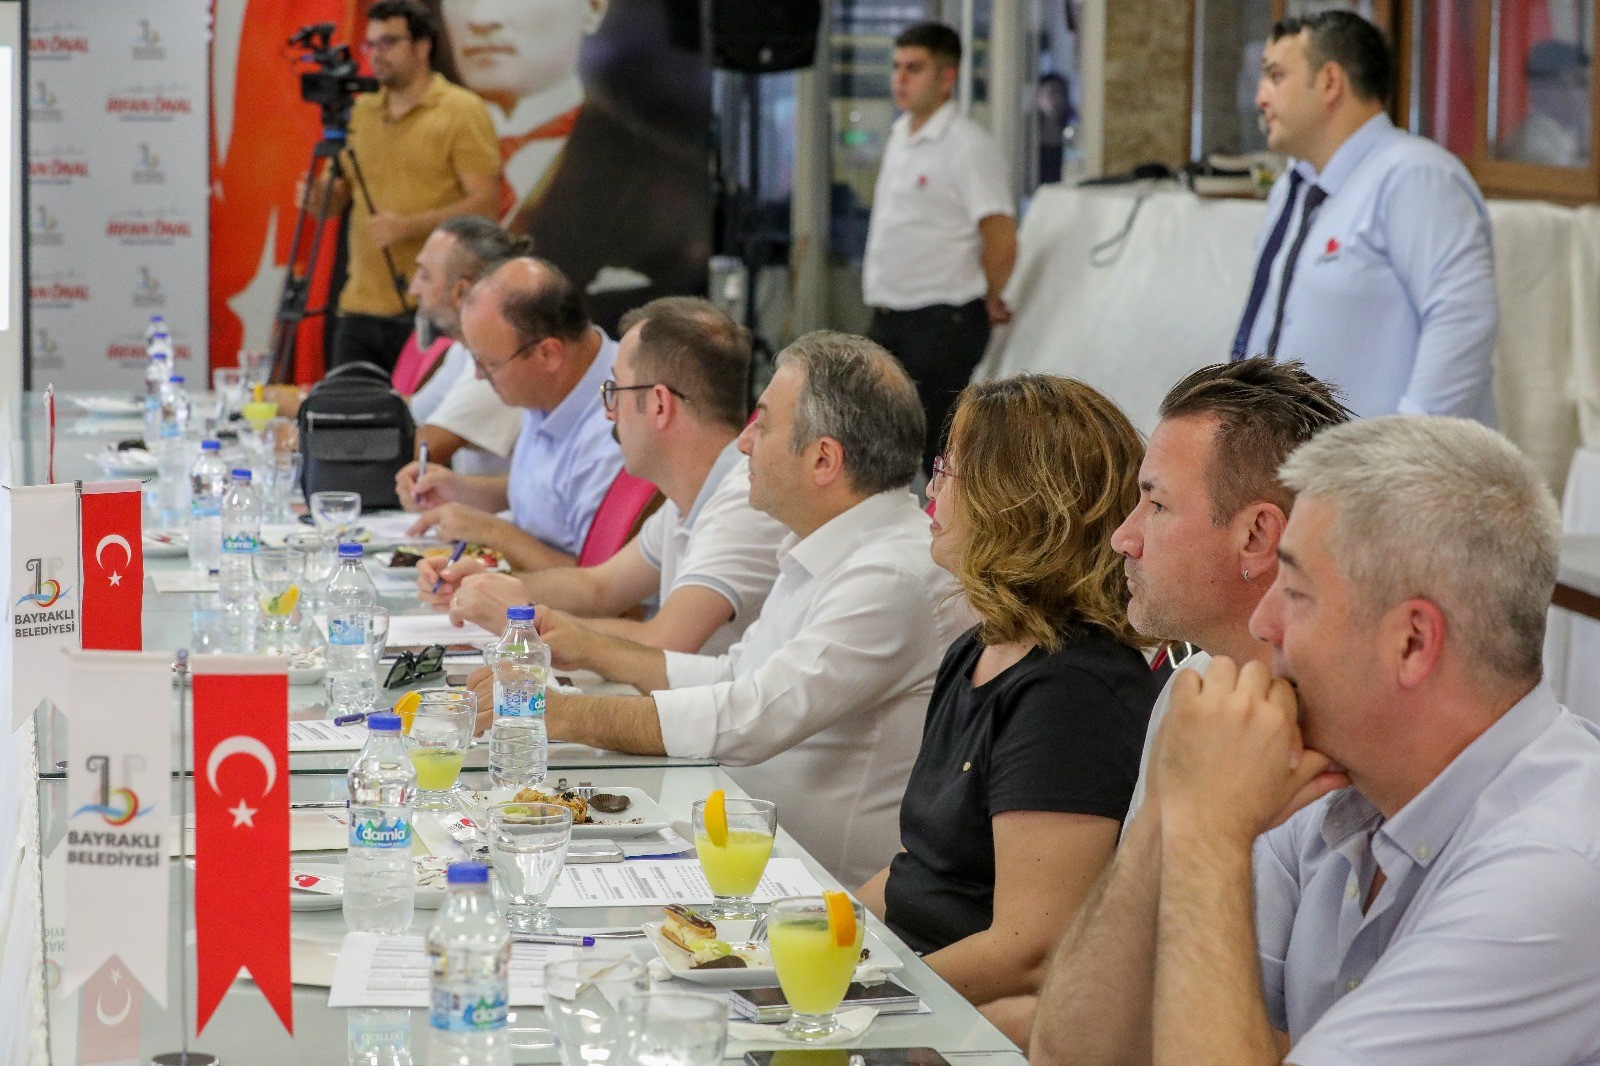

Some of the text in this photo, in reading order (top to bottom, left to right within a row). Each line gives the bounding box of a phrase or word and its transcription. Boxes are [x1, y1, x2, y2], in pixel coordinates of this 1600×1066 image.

[14, 609, 75, 625] BAYRAKLI
[14, 621, 76, 638] BELEDİYESİ
[67, 830, 160, 849] BAYRAKLI
[361, 827, 405, 842] damla
[67, 850, 160, 868] BELEDİYESİ
